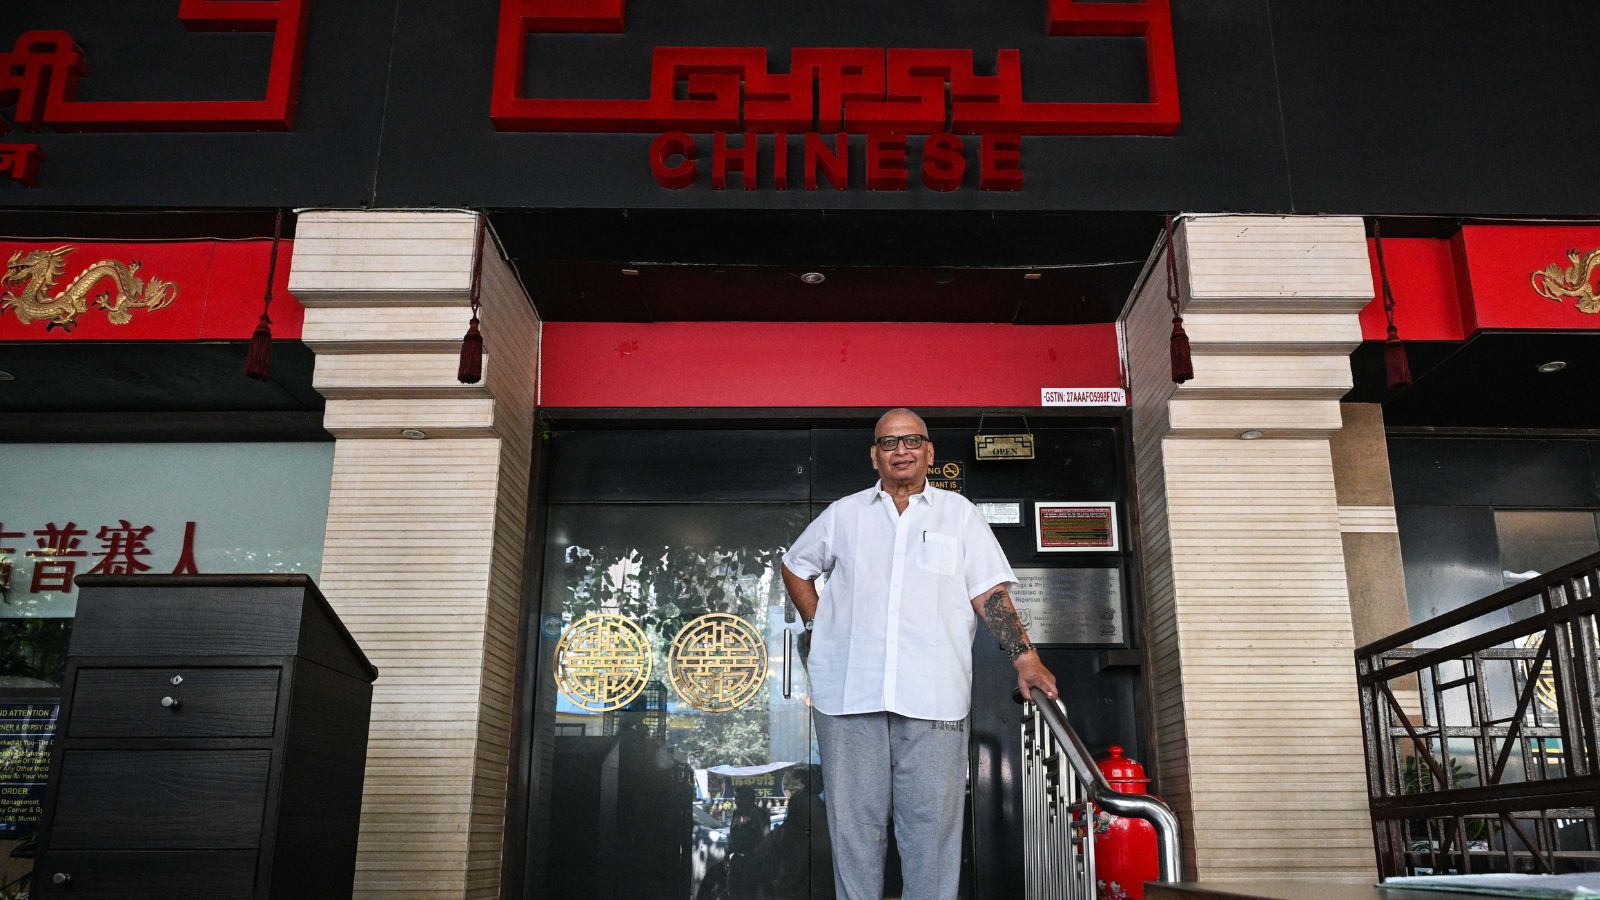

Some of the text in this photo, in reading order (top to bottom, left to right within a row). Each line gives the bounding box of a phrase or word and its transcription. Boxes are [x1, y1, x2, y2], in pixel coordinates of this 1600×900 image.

[651, 46, 1022, 131] GYPSY
[650, 131, 1023, 192] CHINESE
[992, 447, 1018, 456] OPEN
[9, 709, 50, 717] ATTENTION
